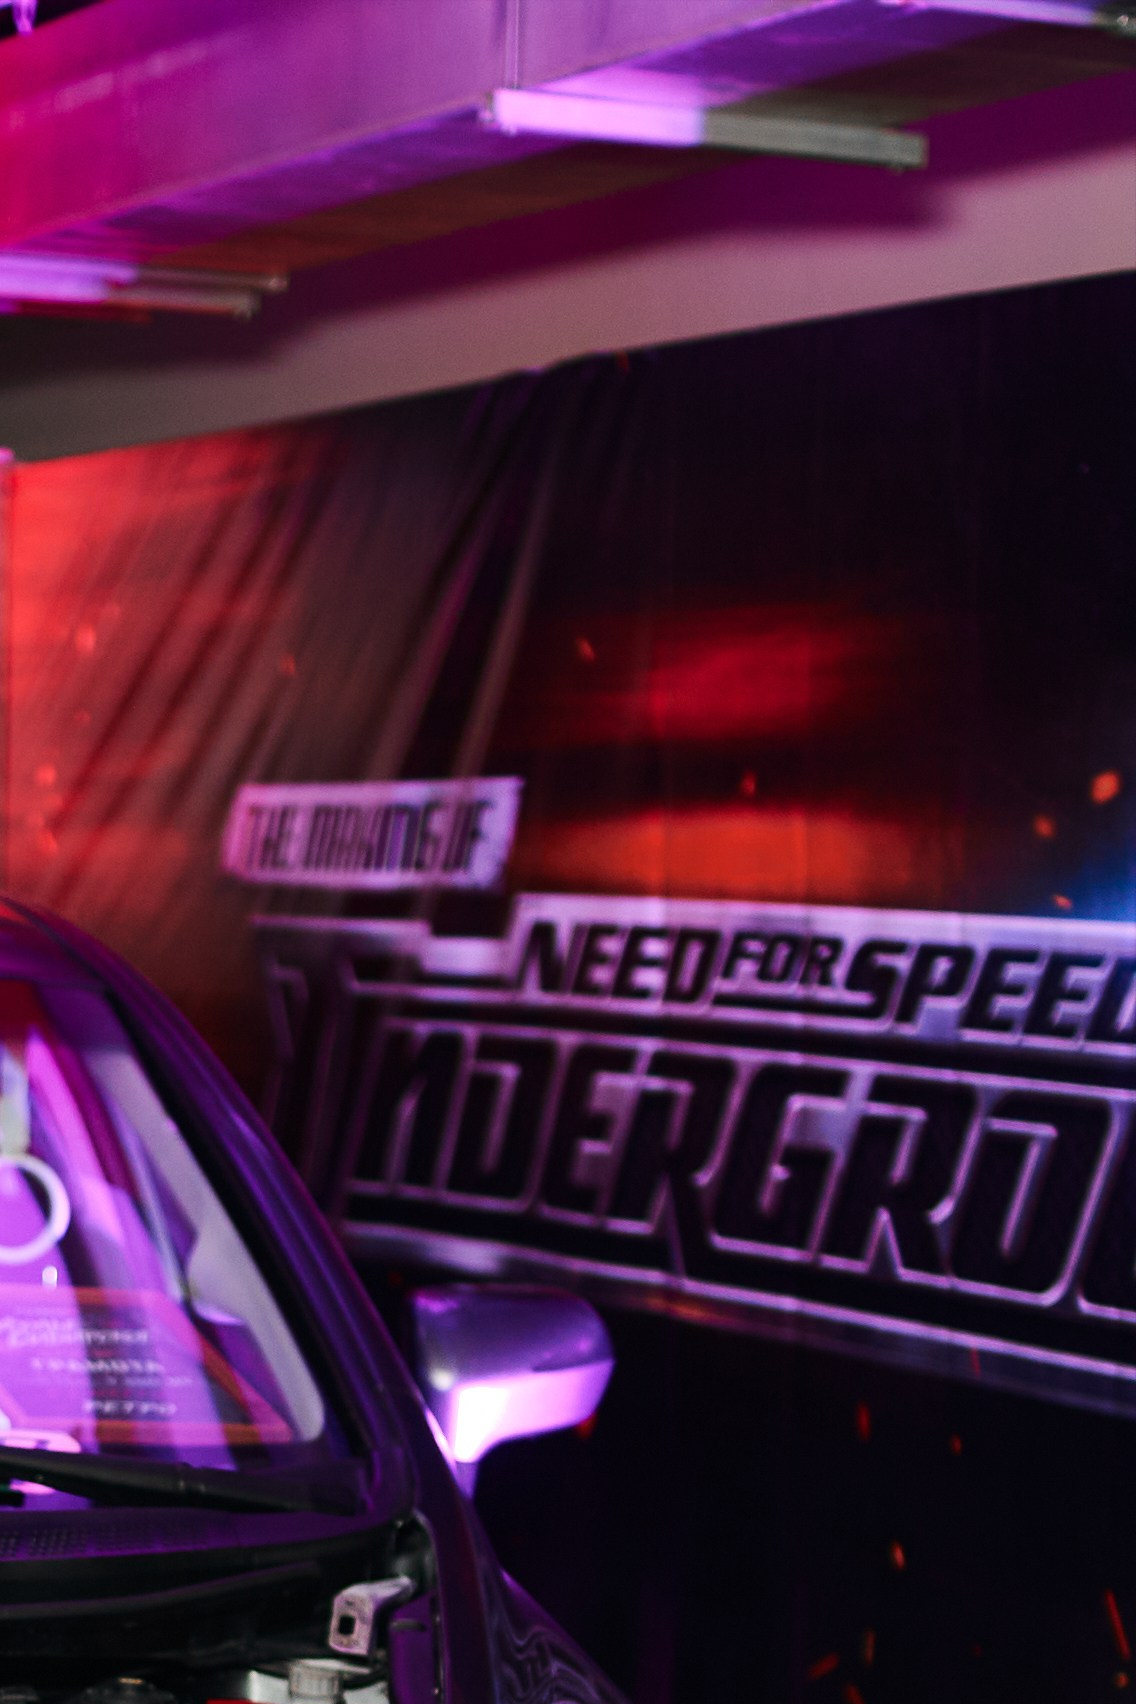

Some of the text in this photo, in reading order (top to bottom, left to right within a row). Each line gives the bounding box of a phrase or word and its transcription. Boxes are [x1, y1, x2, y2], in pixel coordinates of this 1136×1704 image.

[244, 803, 297, 871] THE
[514, 920, 724, 1006] NEED
[721, 930, 846, 988] FOR
